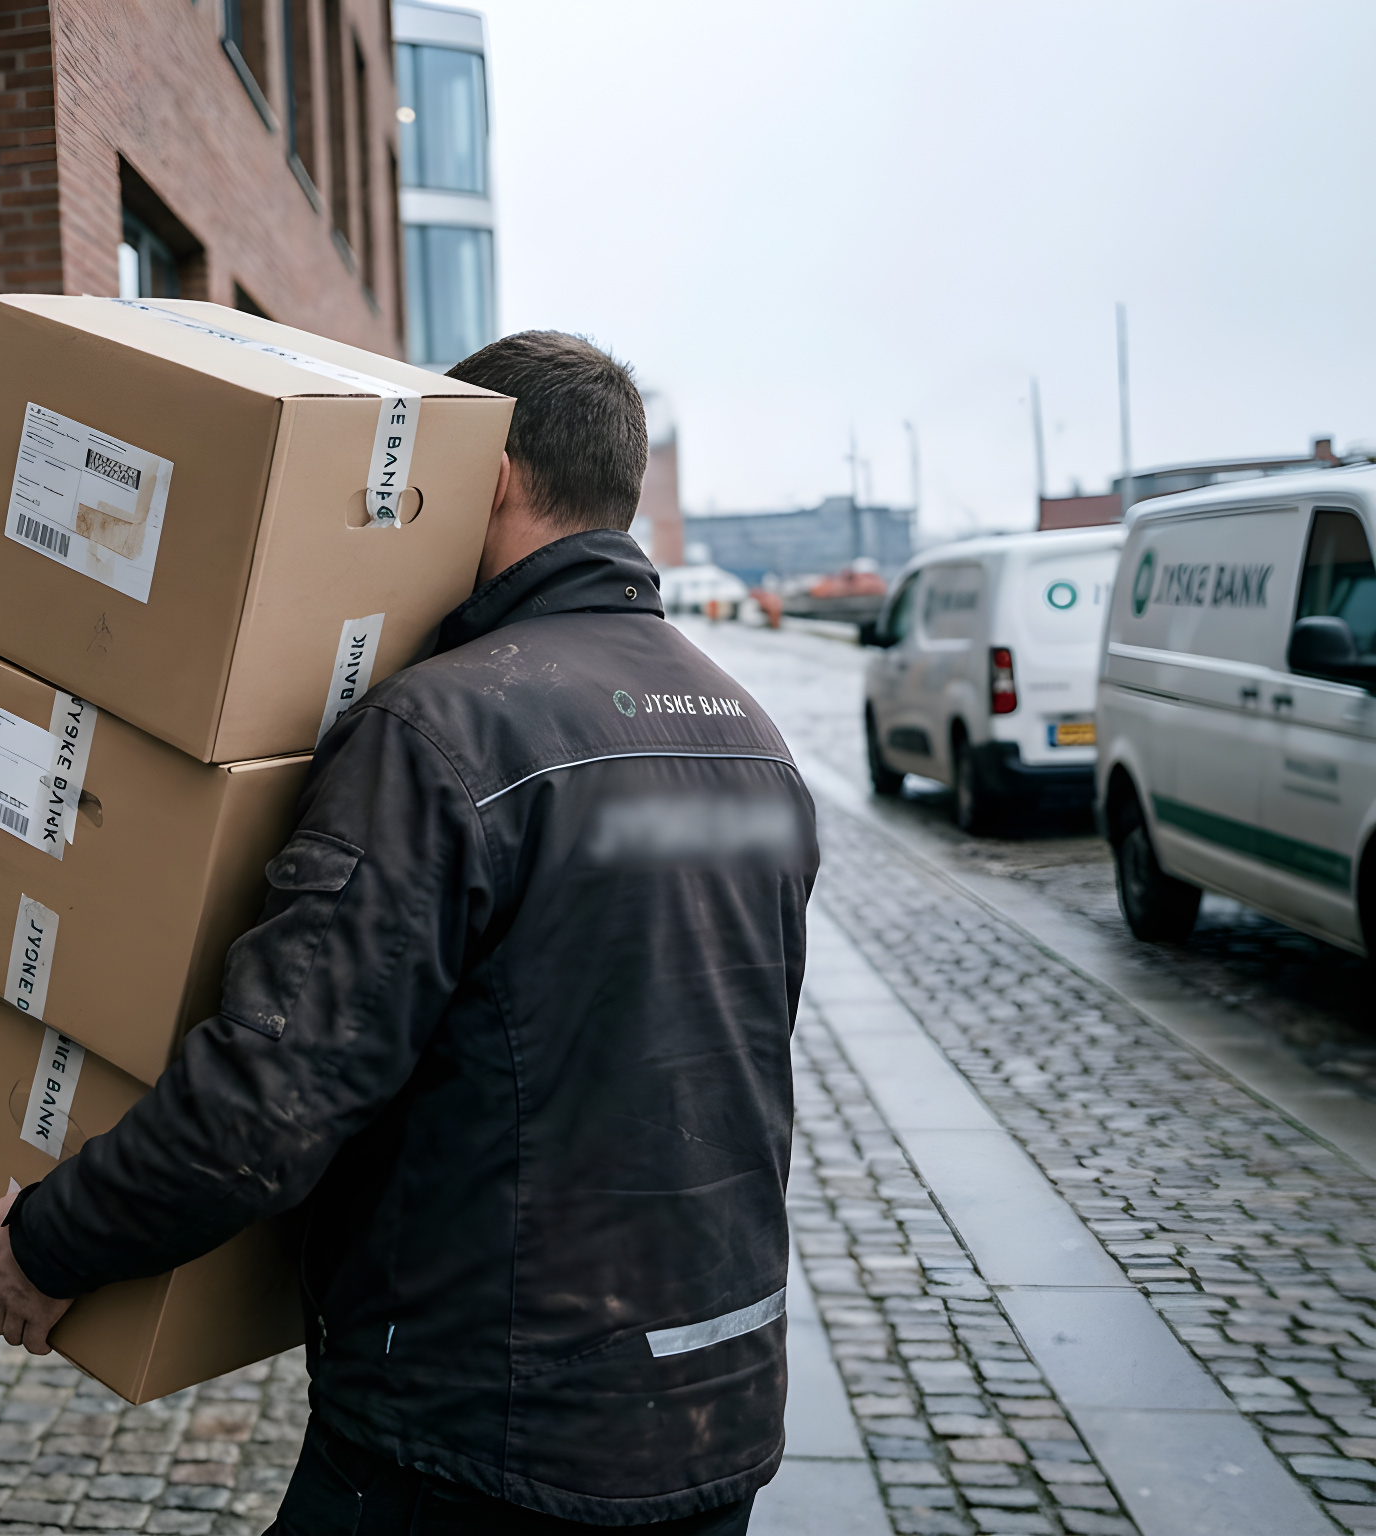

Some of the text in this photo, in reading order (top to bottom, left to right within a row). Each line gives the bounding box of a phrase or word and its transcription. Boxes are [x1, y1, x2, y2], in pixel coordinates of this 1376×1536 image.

[1211, 562, 1274, 608] BANK
[698, 695, 747, 718] BANK
[35, 1077, 62, 1140] BANK
